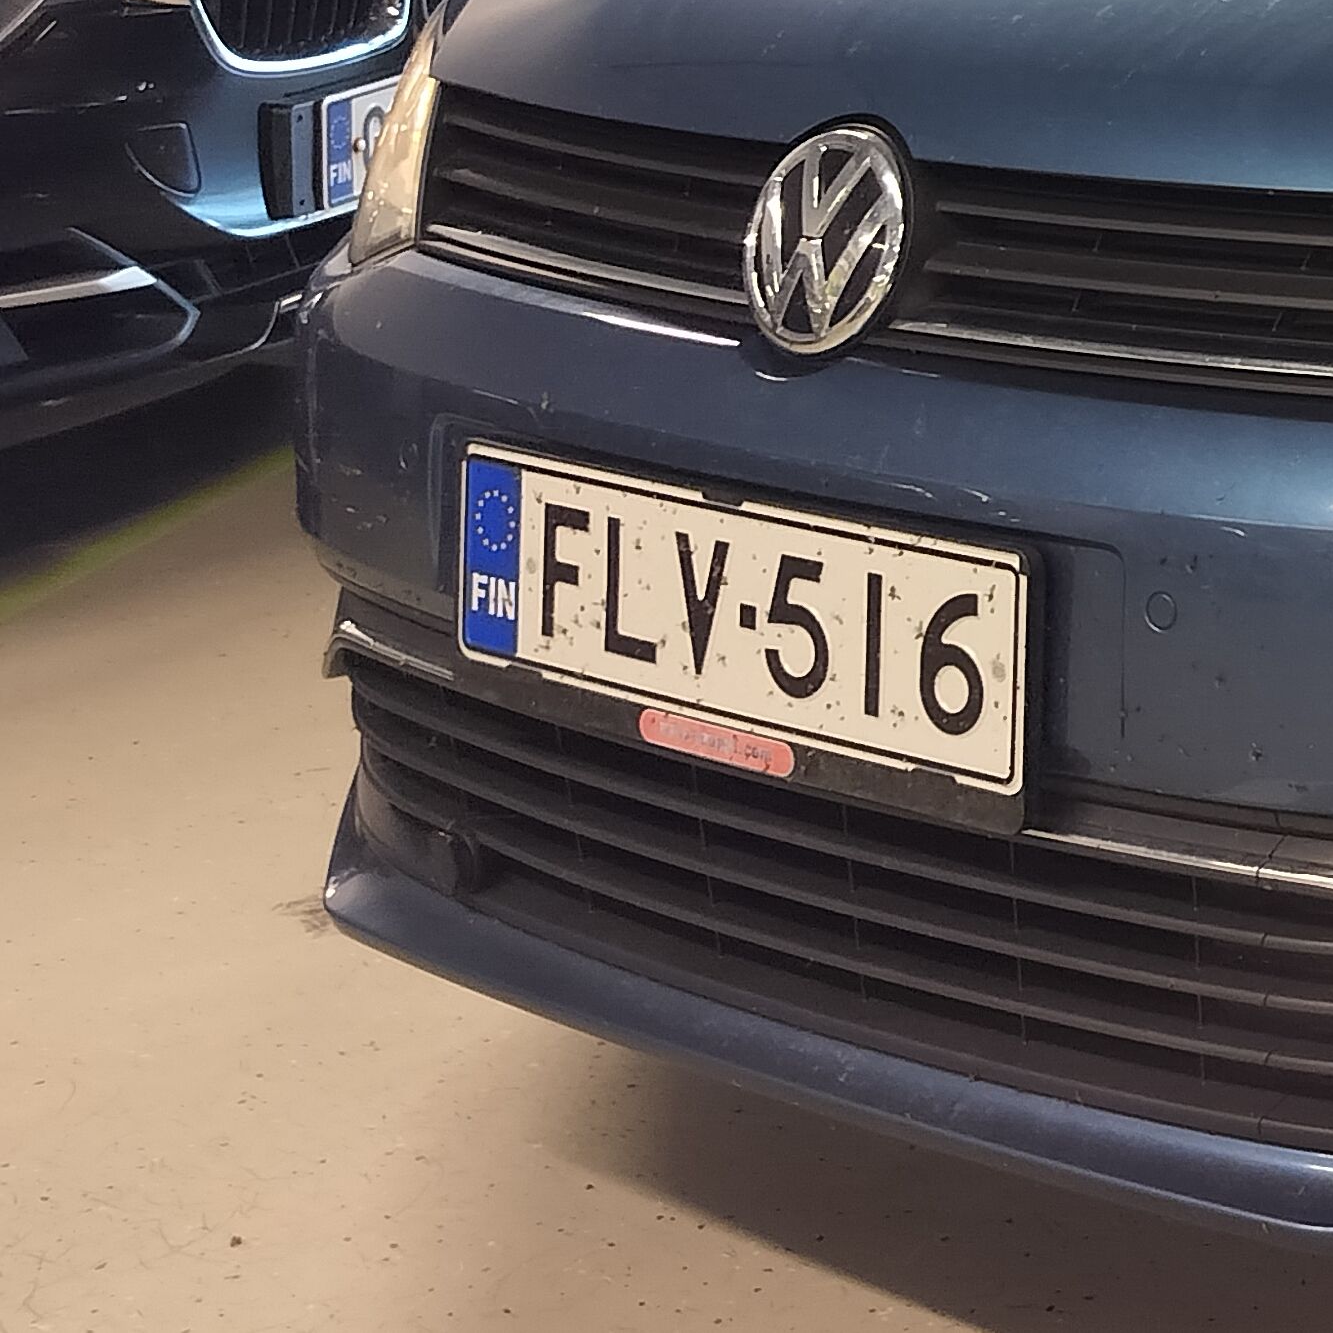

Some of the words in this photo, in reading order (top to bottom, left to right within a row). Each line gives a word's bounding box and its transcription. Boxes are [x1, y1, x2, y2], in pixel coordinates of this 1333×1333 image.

[329, 159, 352, 186] FIN
[471, 572, 516, 621] FIN
[541, 502, 984, 736] FLV-516
